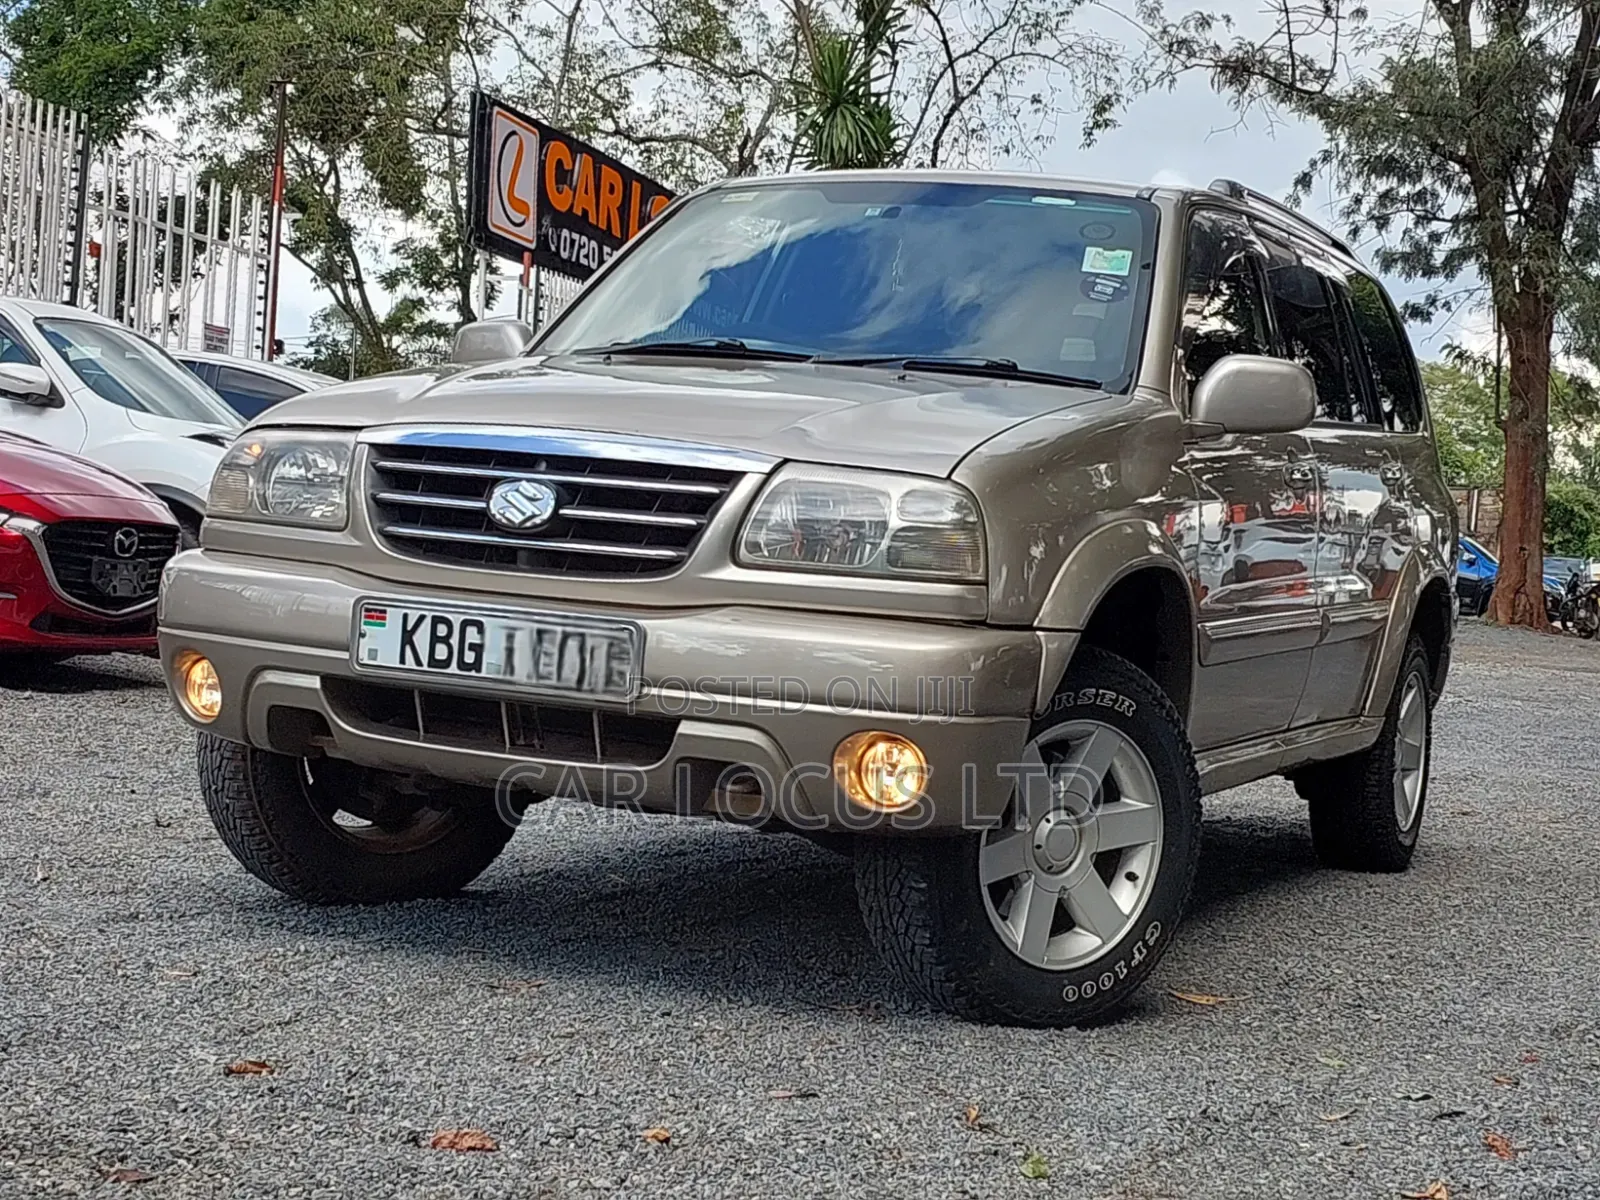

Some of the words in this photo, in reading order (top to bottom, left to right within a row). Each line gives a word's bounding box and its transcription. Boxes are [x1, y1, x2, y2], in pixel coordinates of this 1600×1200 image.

[545, 140, 623, 239] CAR
[560, 228, 599, 271] 0720
[399, 612, 485, 674] KBG
